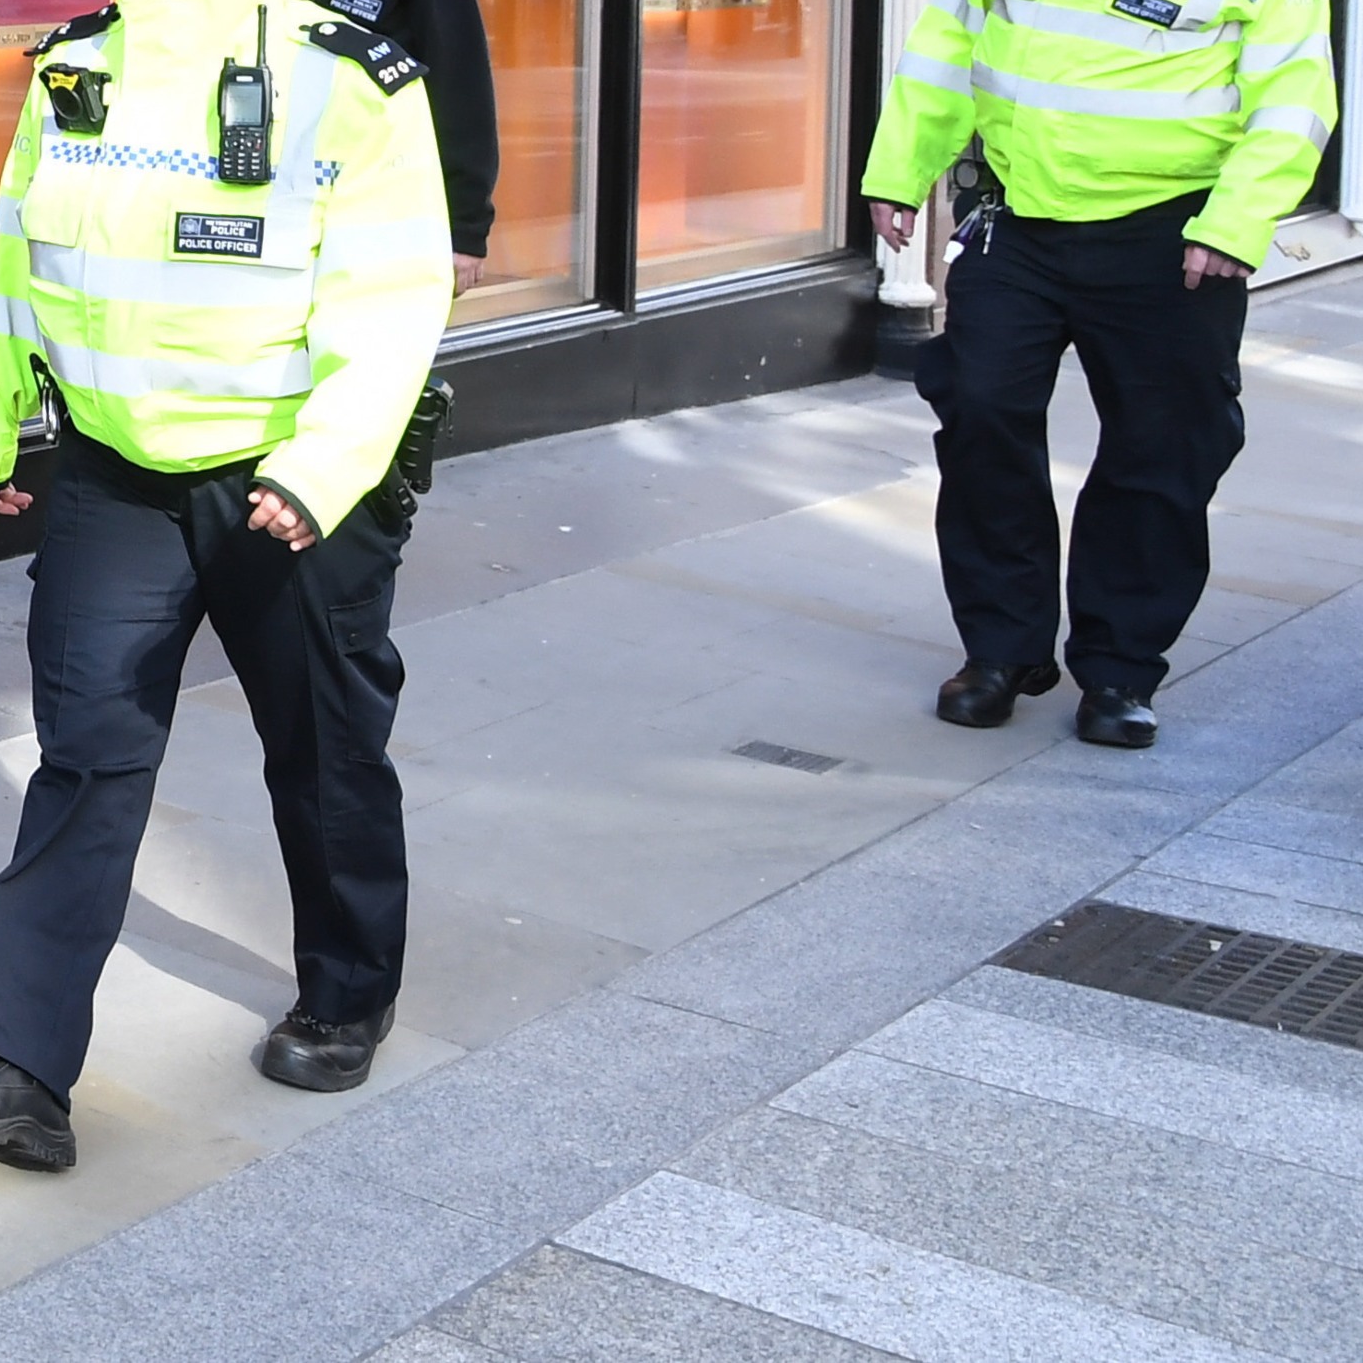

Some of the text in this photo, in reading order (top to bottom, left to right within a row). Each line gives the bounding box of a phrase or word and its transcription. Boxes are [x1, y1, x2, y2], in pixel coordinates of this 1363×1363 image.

[367, 41, 392, 62] AW
[210, 226, 245, 237] POLICE
[178, 238, 258, 253] POLICE OFFICER
